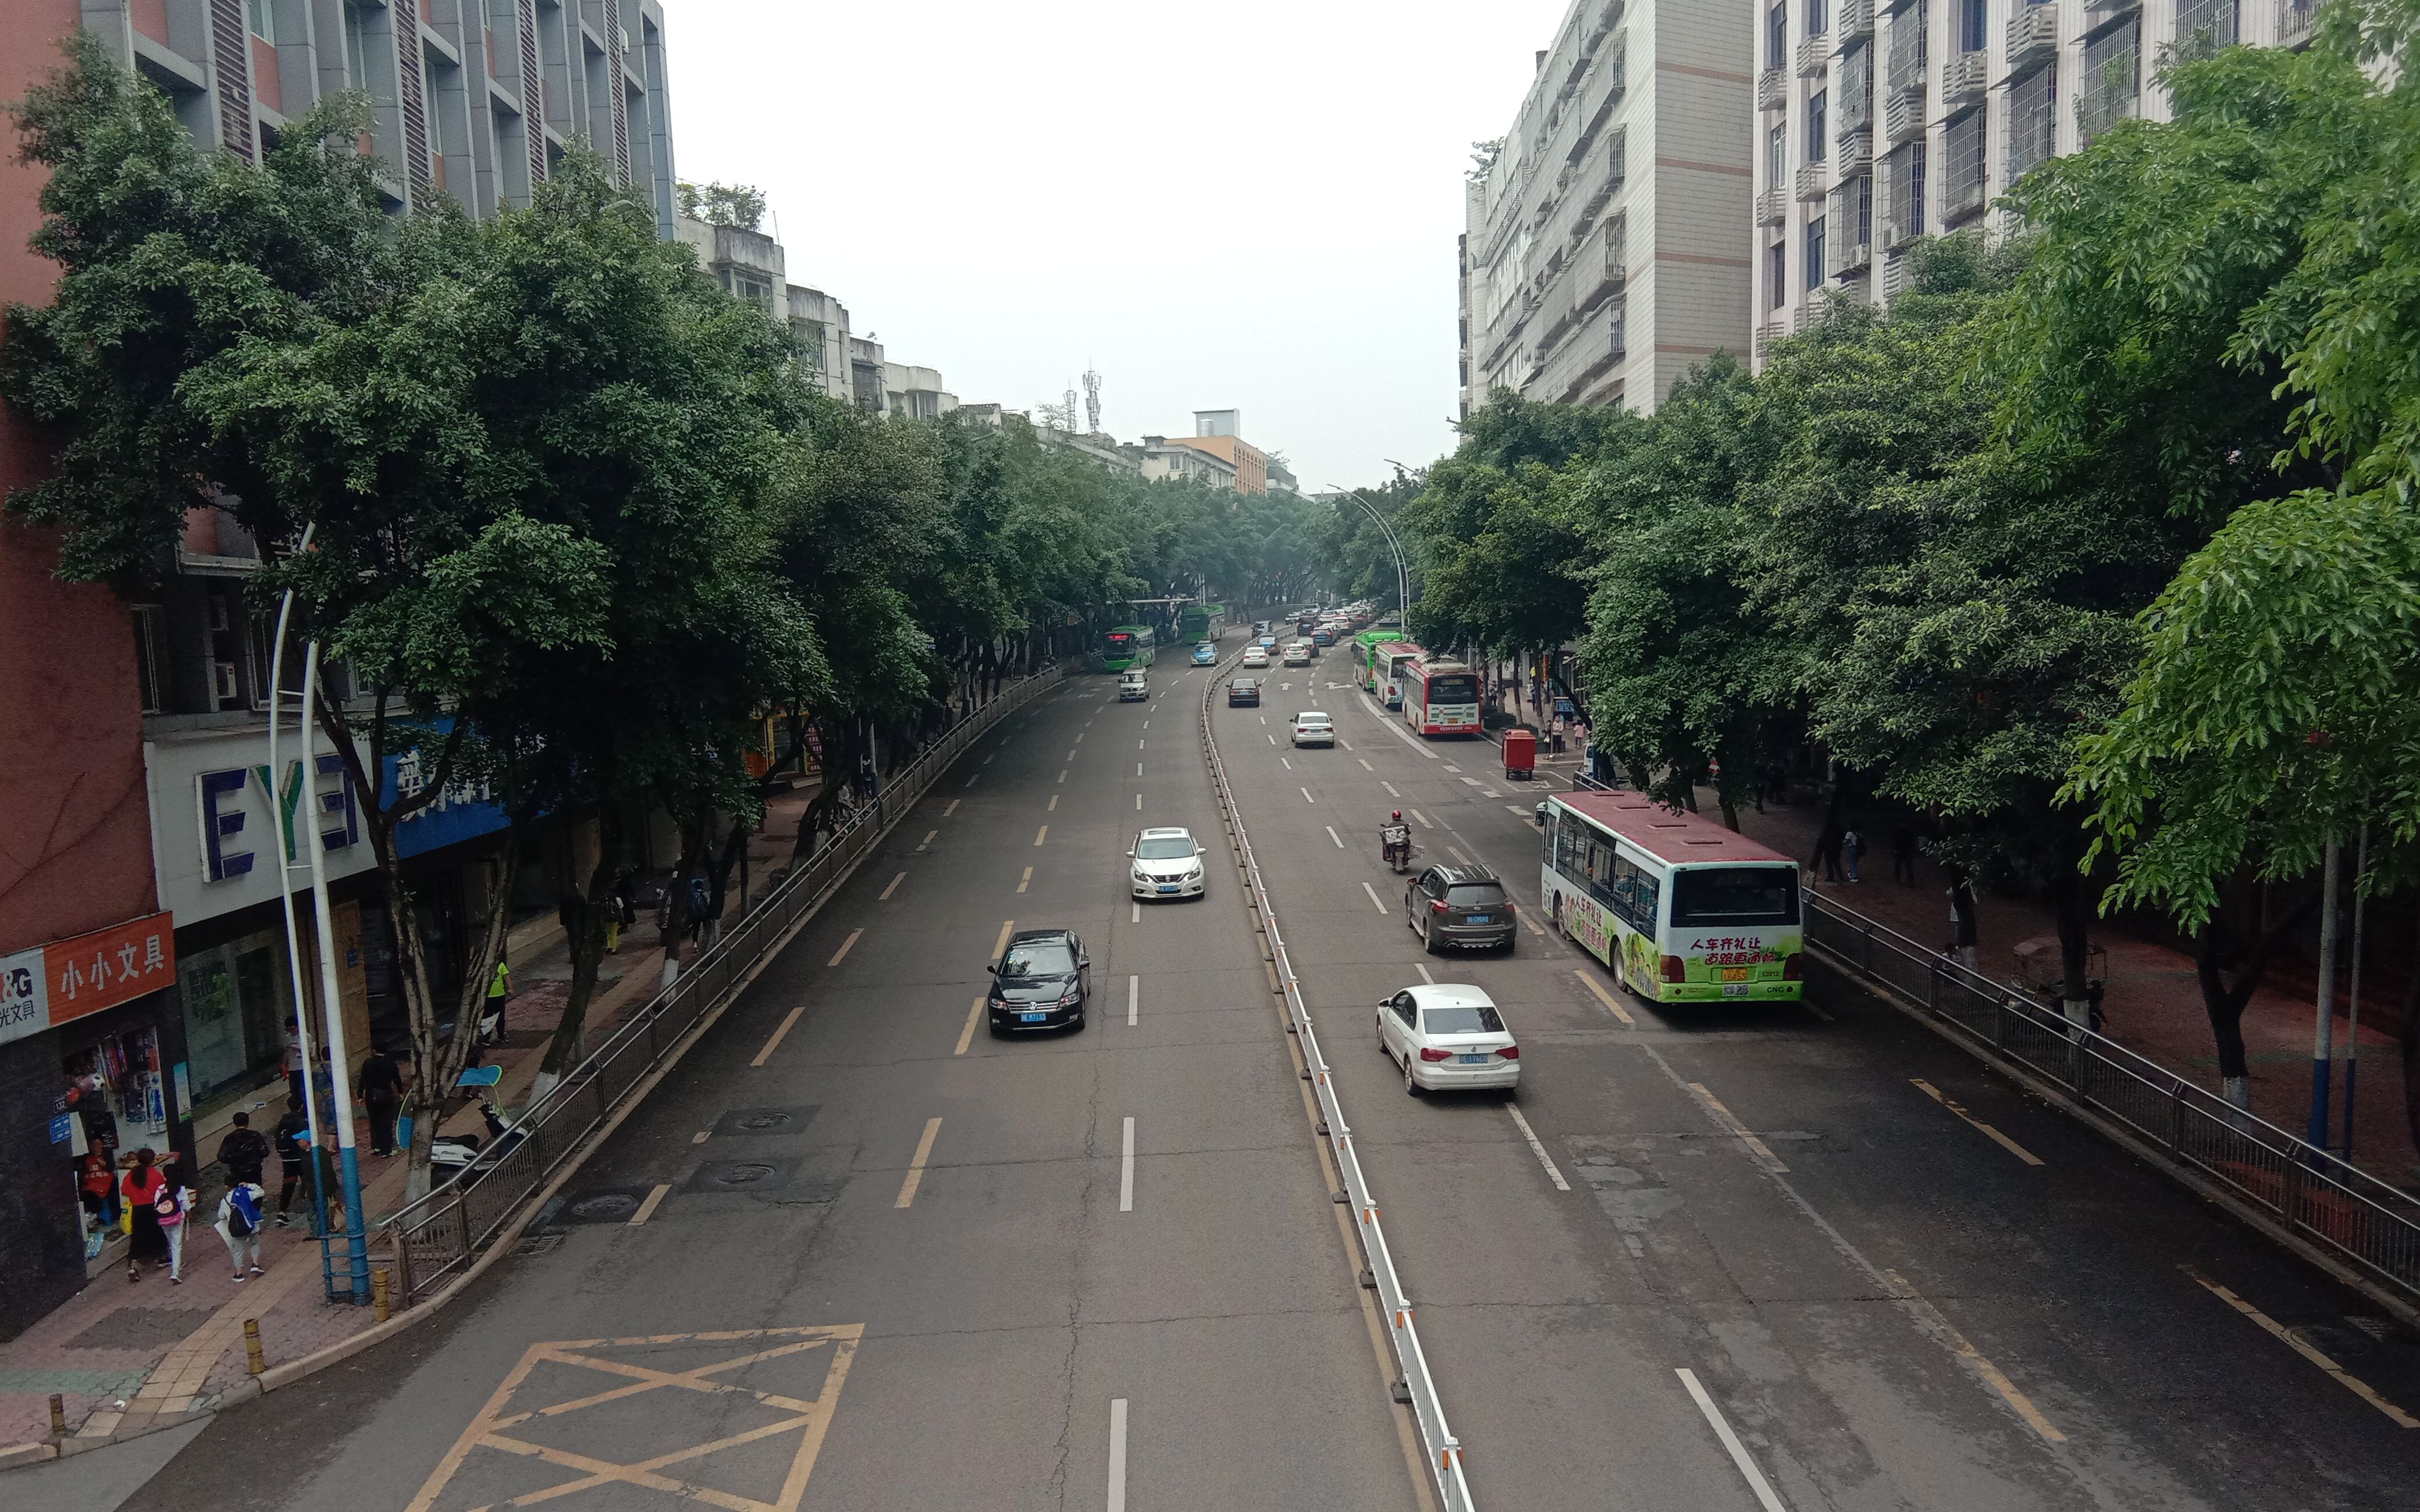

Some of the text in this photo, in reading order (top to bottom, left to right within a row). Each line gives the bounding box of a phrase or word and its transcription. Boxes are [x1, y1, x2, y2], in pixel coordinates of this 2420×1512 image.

[1691, 937, 1761, 950] 人车齐礼让
[1705, 952, 1775, 965] 道路更通畅
[61, 935, 164, 1000] 小小文具
[55, 1100, 66, 1110] 132
